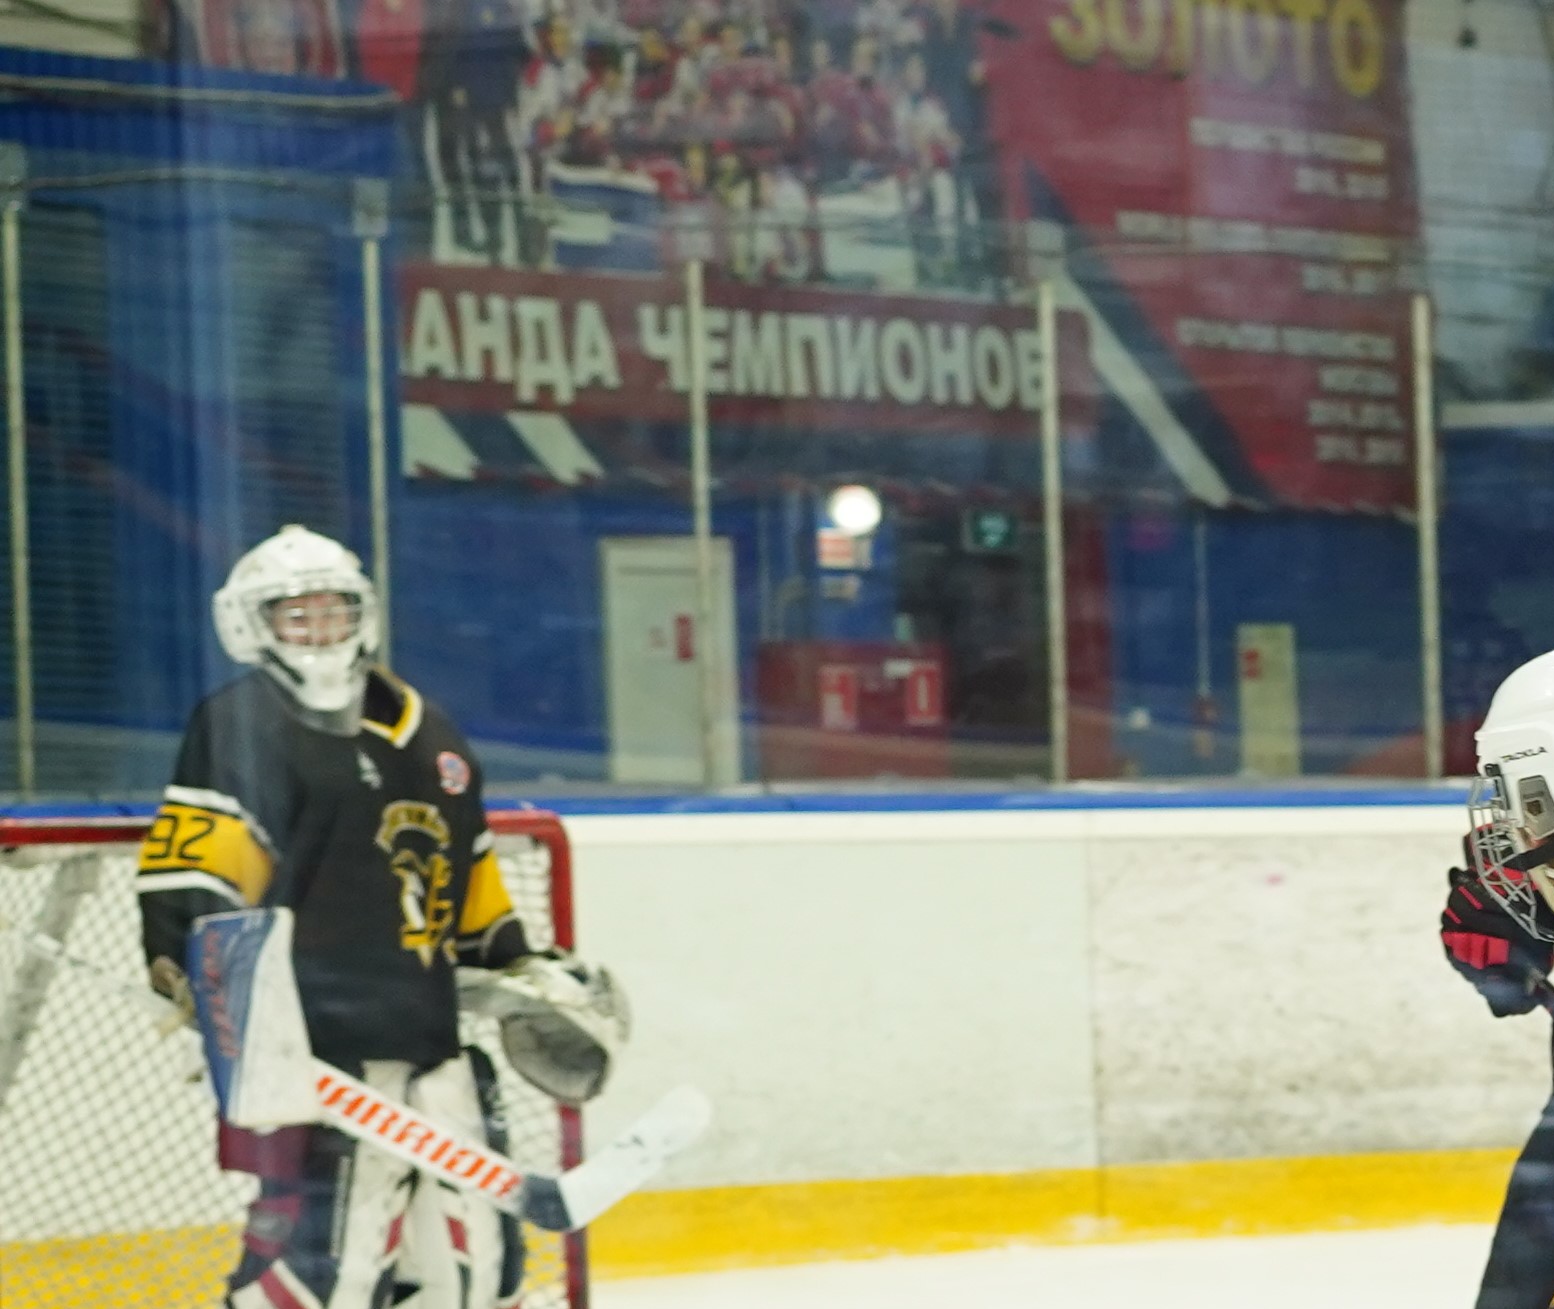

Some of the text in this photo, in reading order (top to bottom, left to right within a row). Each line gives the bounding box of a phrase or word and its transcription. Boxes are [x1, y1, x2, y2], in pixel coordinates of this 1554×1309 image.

[402, 289, 1046, 410] АНДА ЧЕМПИОНОВ
[147, 814, 215, 860] 92
